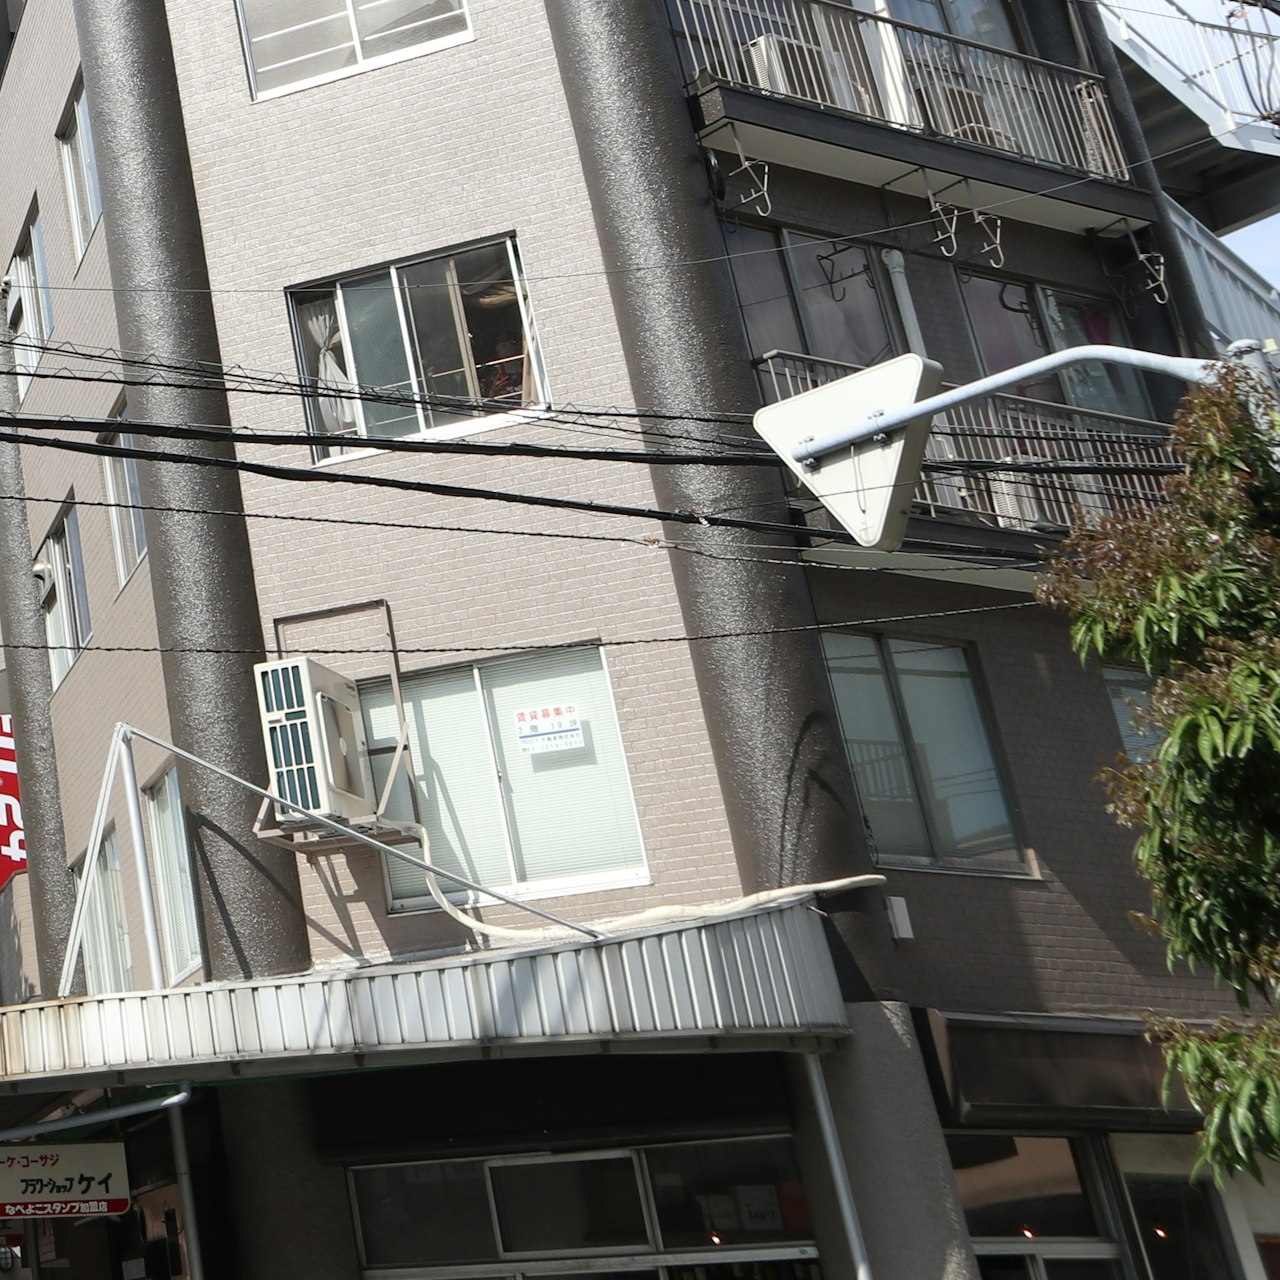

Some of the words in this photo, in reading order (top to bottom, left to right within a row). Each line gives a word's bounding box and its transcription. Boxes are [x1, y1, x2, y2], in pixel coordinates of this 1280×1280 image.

[516, 706, 576, 723] 賃貸募集中
[4, 1200, 108, 1215] なべよこスタンプ加盟店
